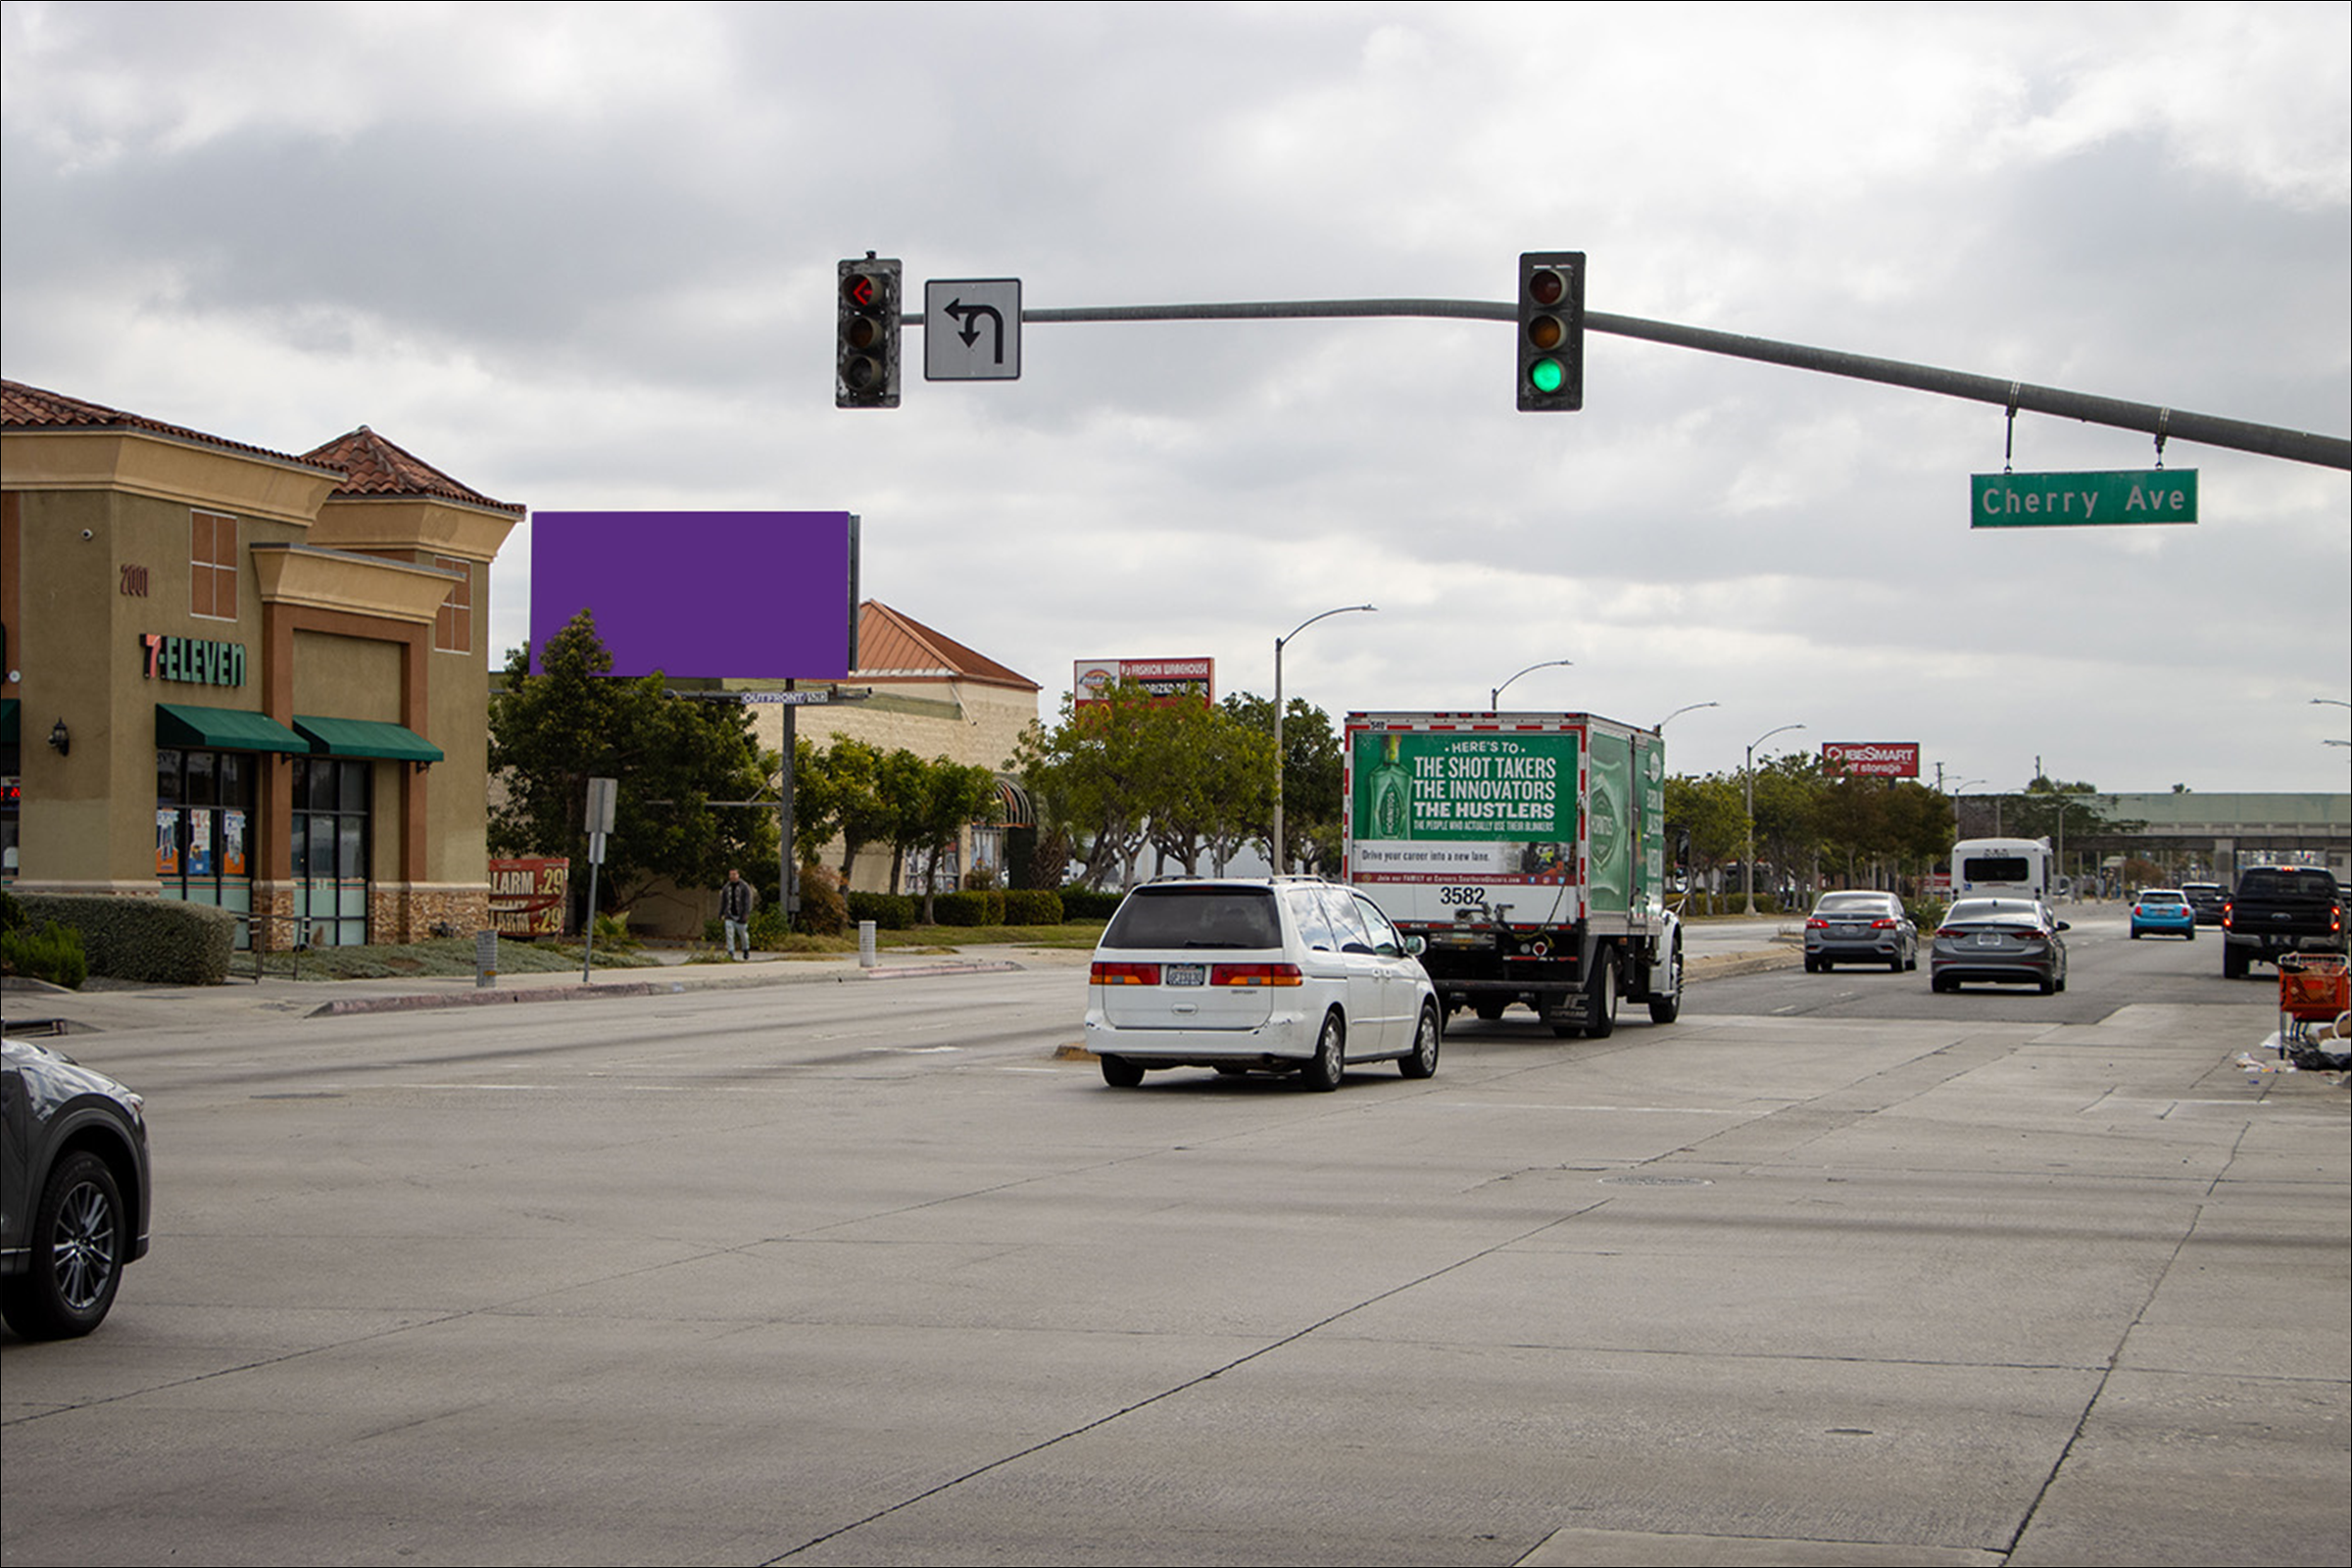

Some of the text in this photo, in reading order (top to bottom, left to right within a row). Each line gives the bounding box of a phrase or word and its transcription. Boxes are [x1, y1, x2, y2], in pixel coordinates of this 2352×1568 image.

[1983, 485, 2185, 518] Cherry Ave
[120, 564, 148, 598] 2001
[743, 692, 804, 704] OUTFRONT
[1451, 741, 1519, 754] HERE'S TO
[1414, 757, 1556, 779] THE SHOT TAKERS
[1860, 763, 1902, 775] storage
[1414, 780, 1556, 801] THE INNOVATORS
[1414, 802, 1555, 819] THE HUSTLERS
[1426, 820, 1448, 831] PEOPLE
[1449, 820, 1463, 831] WHO
[1464, 820, 1493, 832] ACTUALLY
[1494, 821, 1505, 832] USE
[1506, 821, 1523, 832] THEIR
[1362, 850, 1490, 862] Drive your career into a new lane.
[488, 871, 535, 896] LARM
[1440, 886, 1486, 906] 3582
[489, 912, 530, 934] LARM
